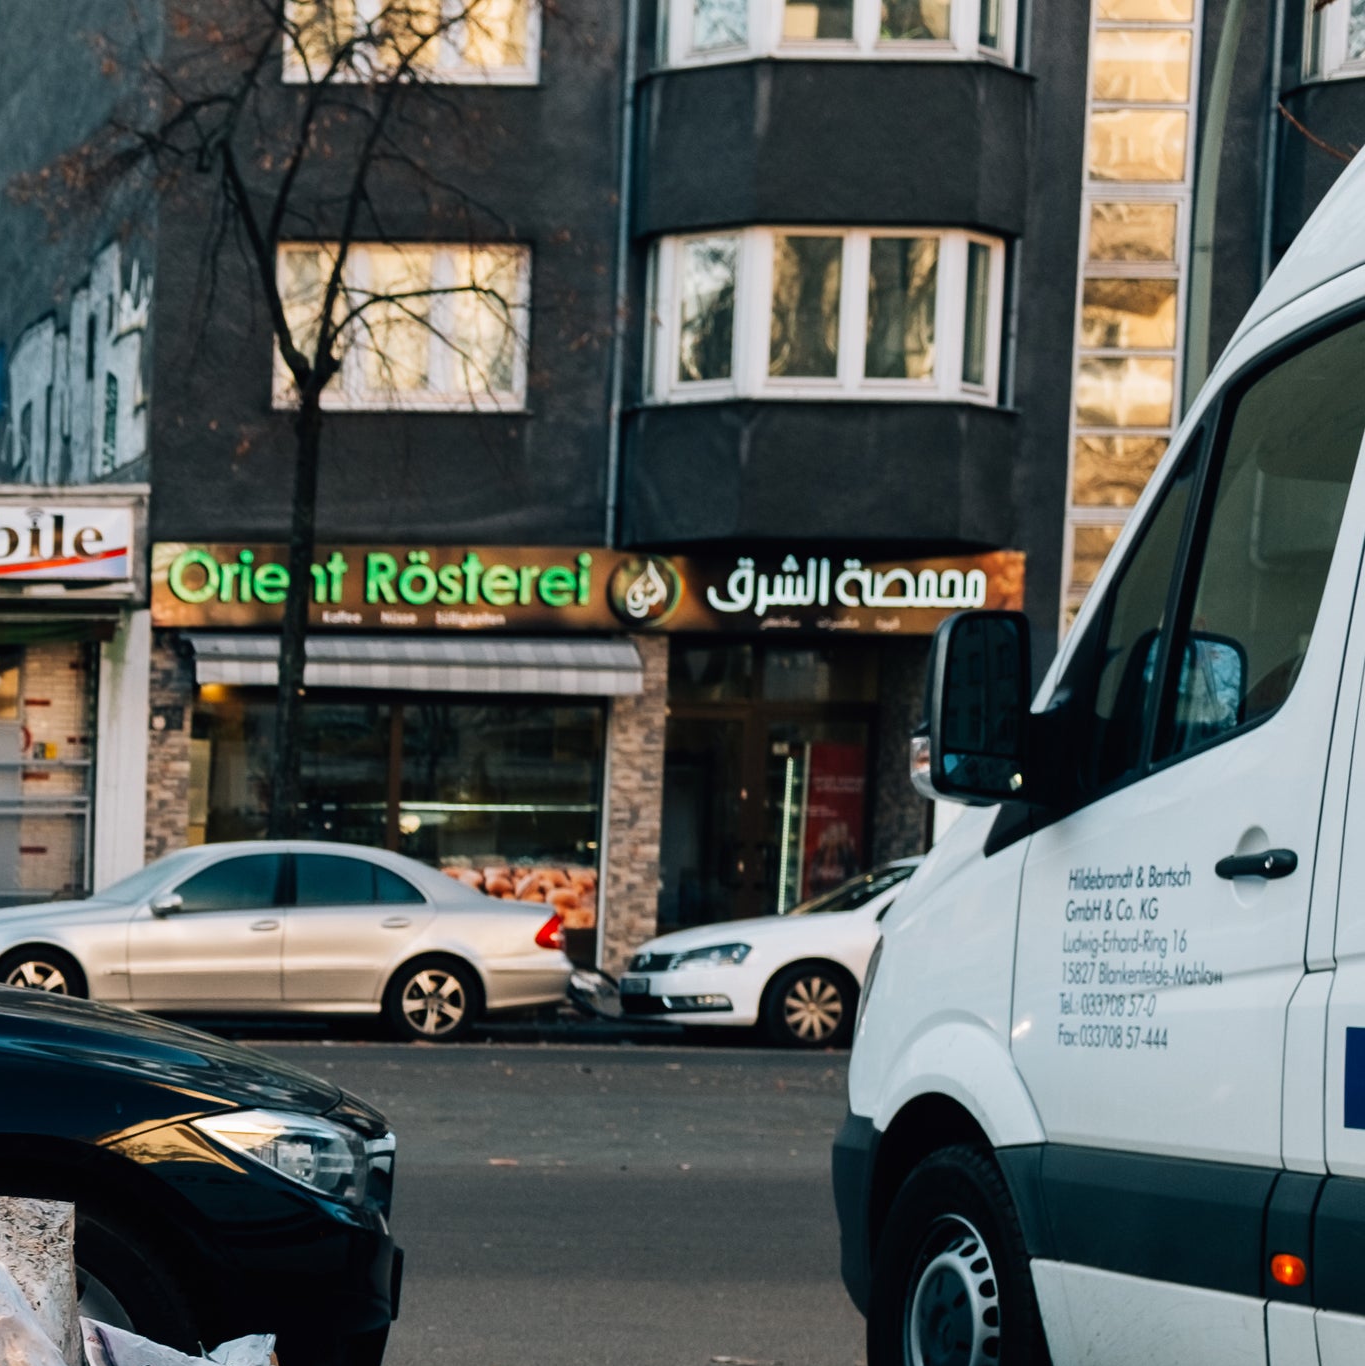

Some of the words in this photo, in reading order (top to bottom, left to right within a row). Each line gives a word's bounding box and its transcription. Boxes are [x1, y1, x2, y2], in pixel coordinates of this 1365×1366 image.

[367, 551, 592, 607] Rösterei
[1069, 866, 1133, 890] Hildebrandt
[1135, 866, 1144, 888] &
[1148, 862, 1191, 887] Bartsch
[1066, 900, 1102, 921] GmbH
[1104, 899, 1112, 921] &
[1116, 898, 1135, 921] Co.
[1140, 897, 1158, 920] KG
[1062, 929, 1168, 959] Ludwig-Erhard-Ring
[1173, 929, 1187, 953] 16
[1062, 961, 1096, 984] 15827
[1098, 960, 1223, 985] Blankenfelde-Mahlow
[1081, 993, 1125, 1016] 033708
[1127, 993, 1156, 1017] 57-0
[1080, 1025, 1122, 1048] 033708
[1126, 1026, 1167, 1049] 57-444
